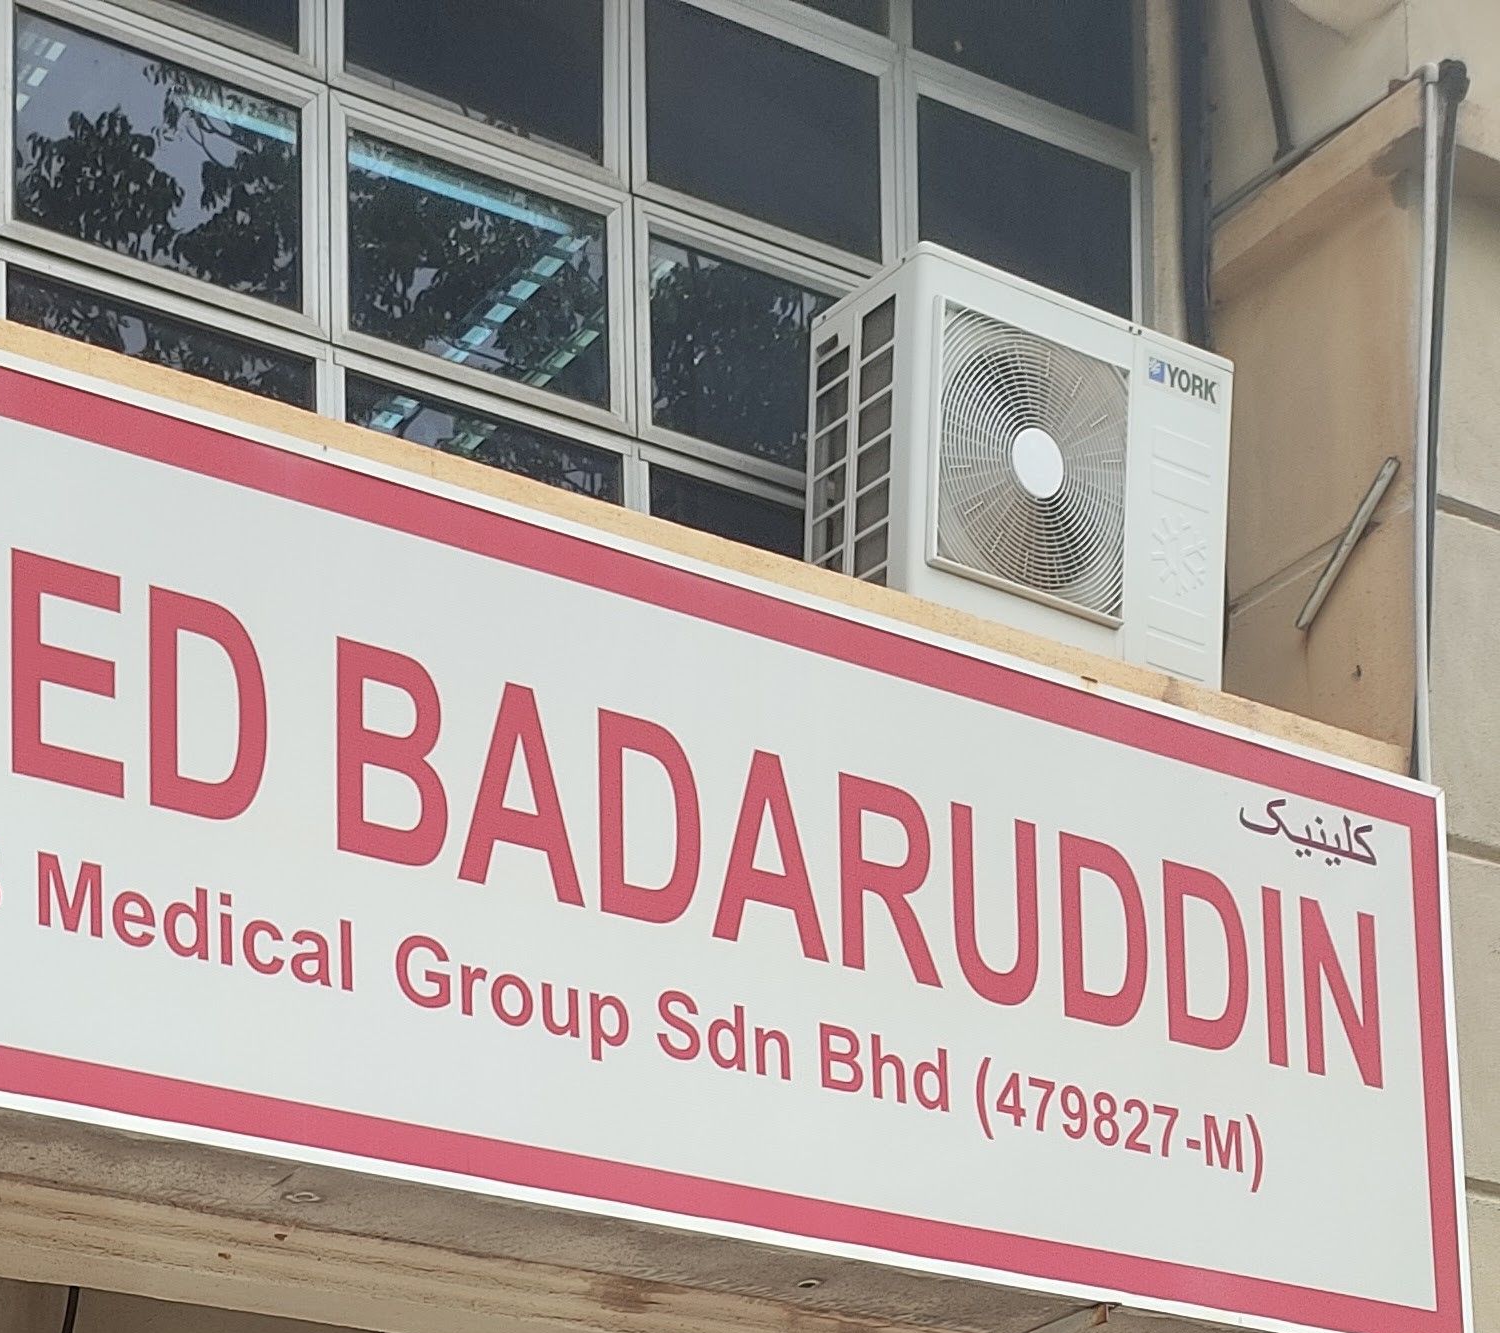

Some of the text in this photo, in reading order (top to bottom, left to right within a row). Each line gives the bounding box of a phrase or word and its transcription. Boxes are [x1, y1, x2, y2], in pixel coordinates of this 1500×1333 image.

[1167, 364, 1217, 404] YORK
[37, 850, 355, 994] Medical
[395, 933, 632, 1064] Group
[656, 990, 794, 1083] Sdn
[818, 1024, 952, 1114] Bhd
[974, 1055, 1267, 1195] (479827-M)
[336, 636, 1385, 1090] BADARUDDIN
